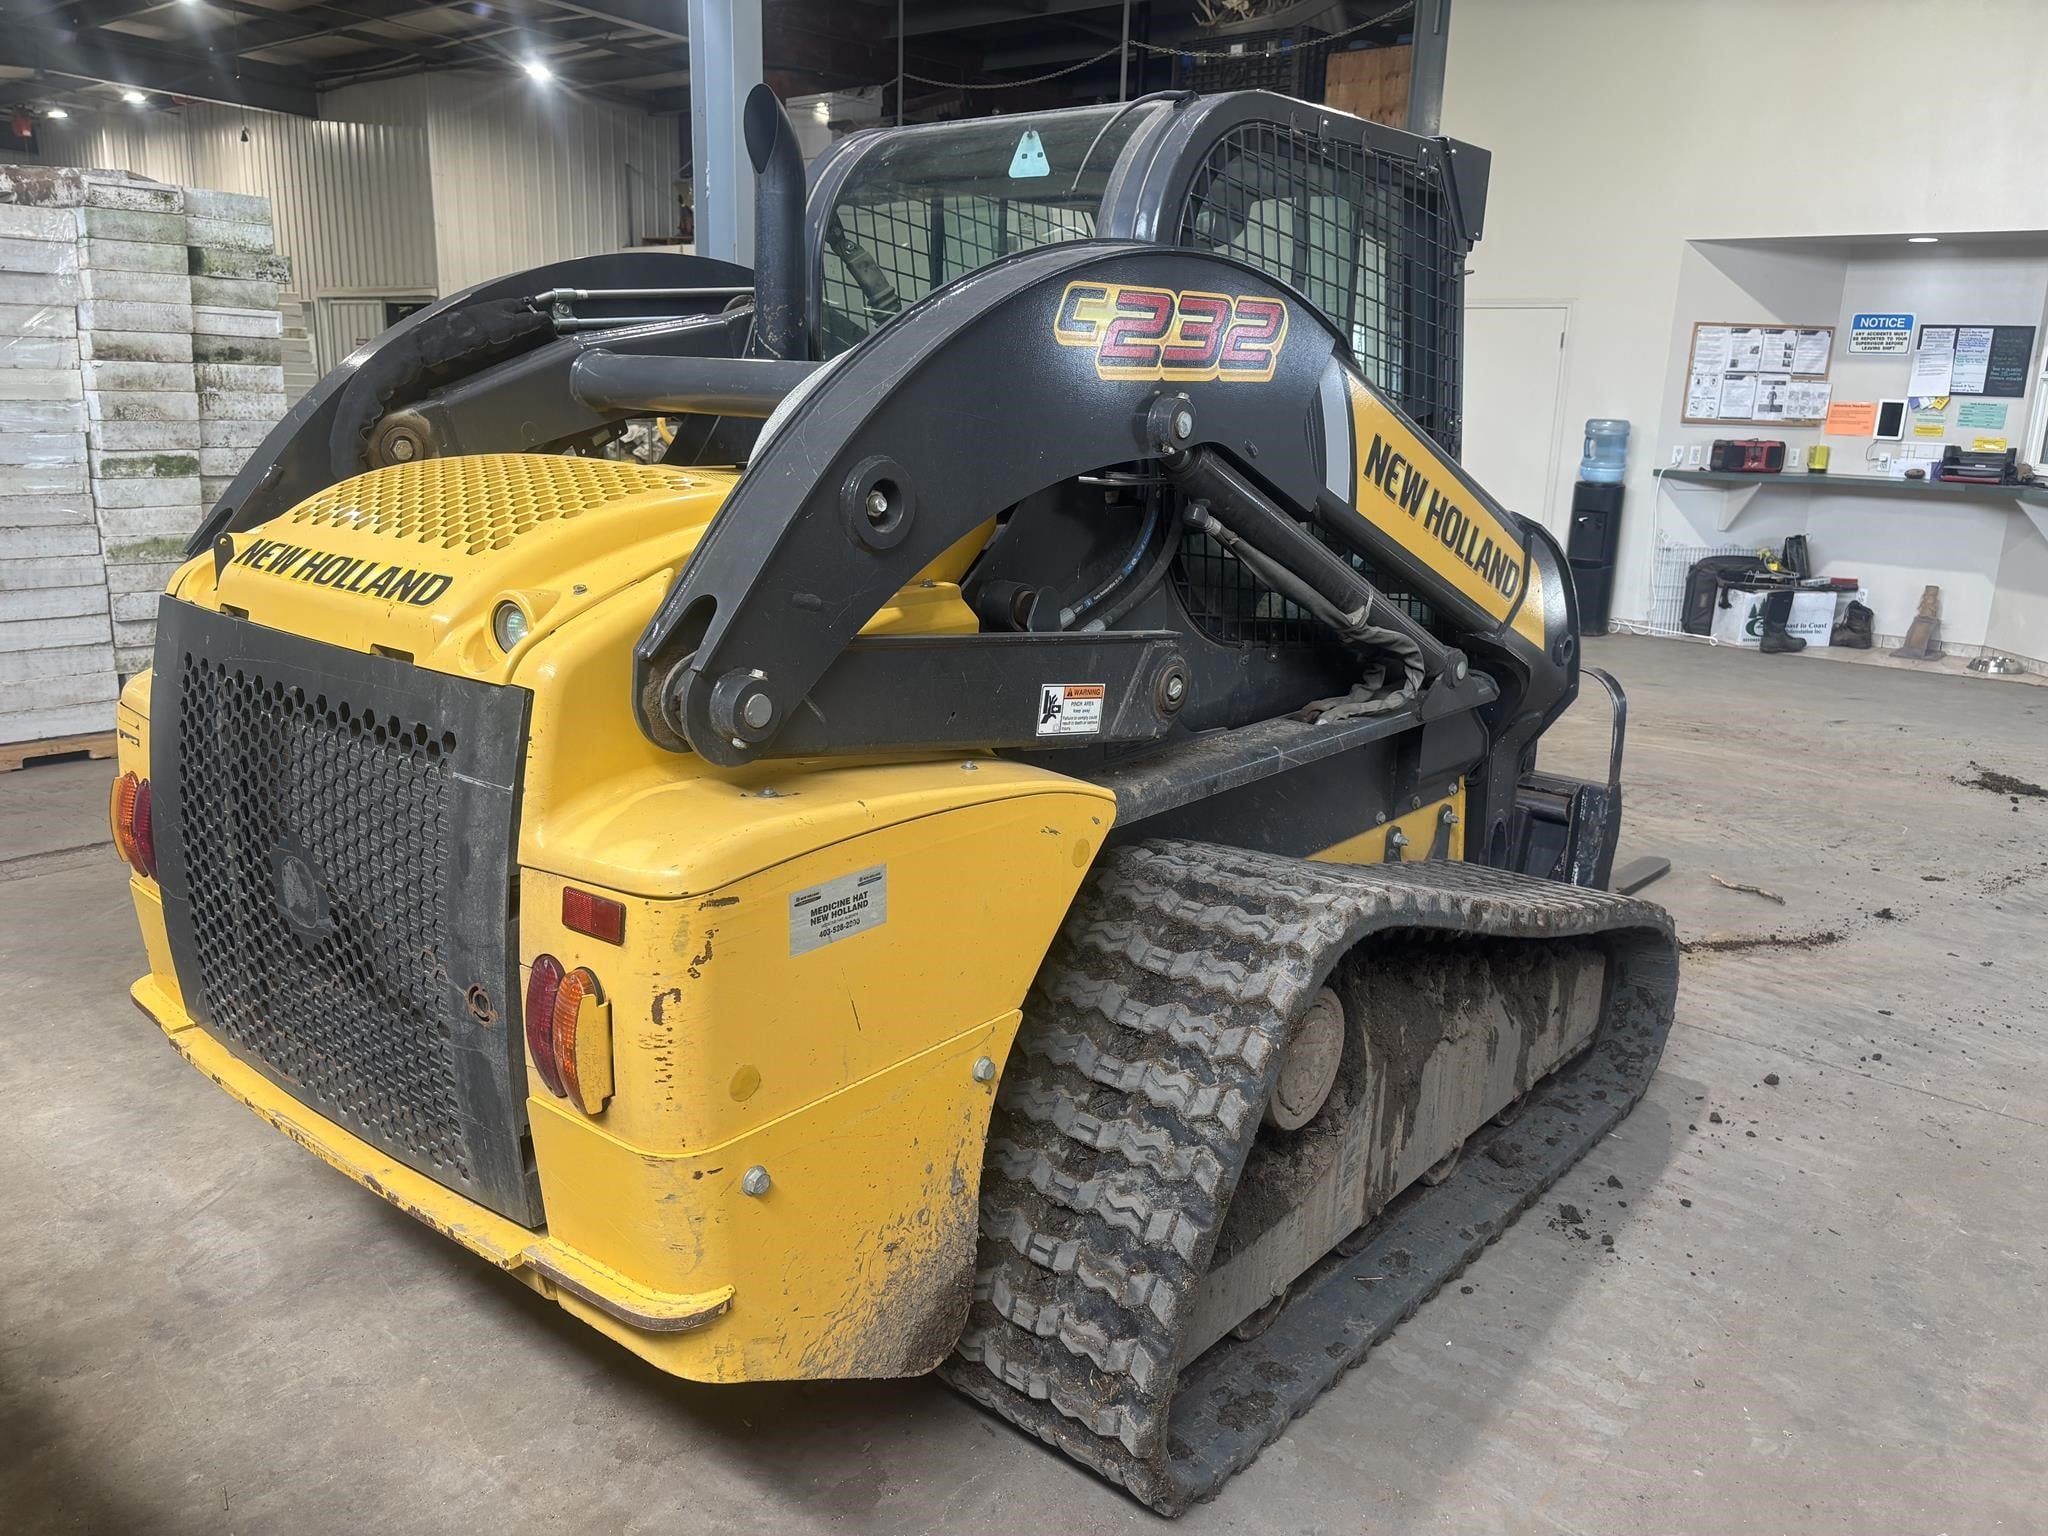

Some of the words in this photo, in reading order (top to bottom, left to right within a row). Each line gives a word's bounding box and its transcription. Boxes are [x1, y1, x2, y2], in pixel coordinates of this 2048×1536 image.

[1054, 281, 1288, 382] C232
[1860, 318, 1906, 328] NOTICE
[1363, 433, 1430, 519] NEW
[1423, 488, 1520, 599] HOLLAND
[233, 538, 312, 575] NEW
[292, 548, 454, 606] HOLLAND
[811, 897, 850, 917] MEDICINE
[853, 891, 868, 903] HAT
[811, 913, 829, 926] NEW
[832, 900, 868, 919] HOLLAND
